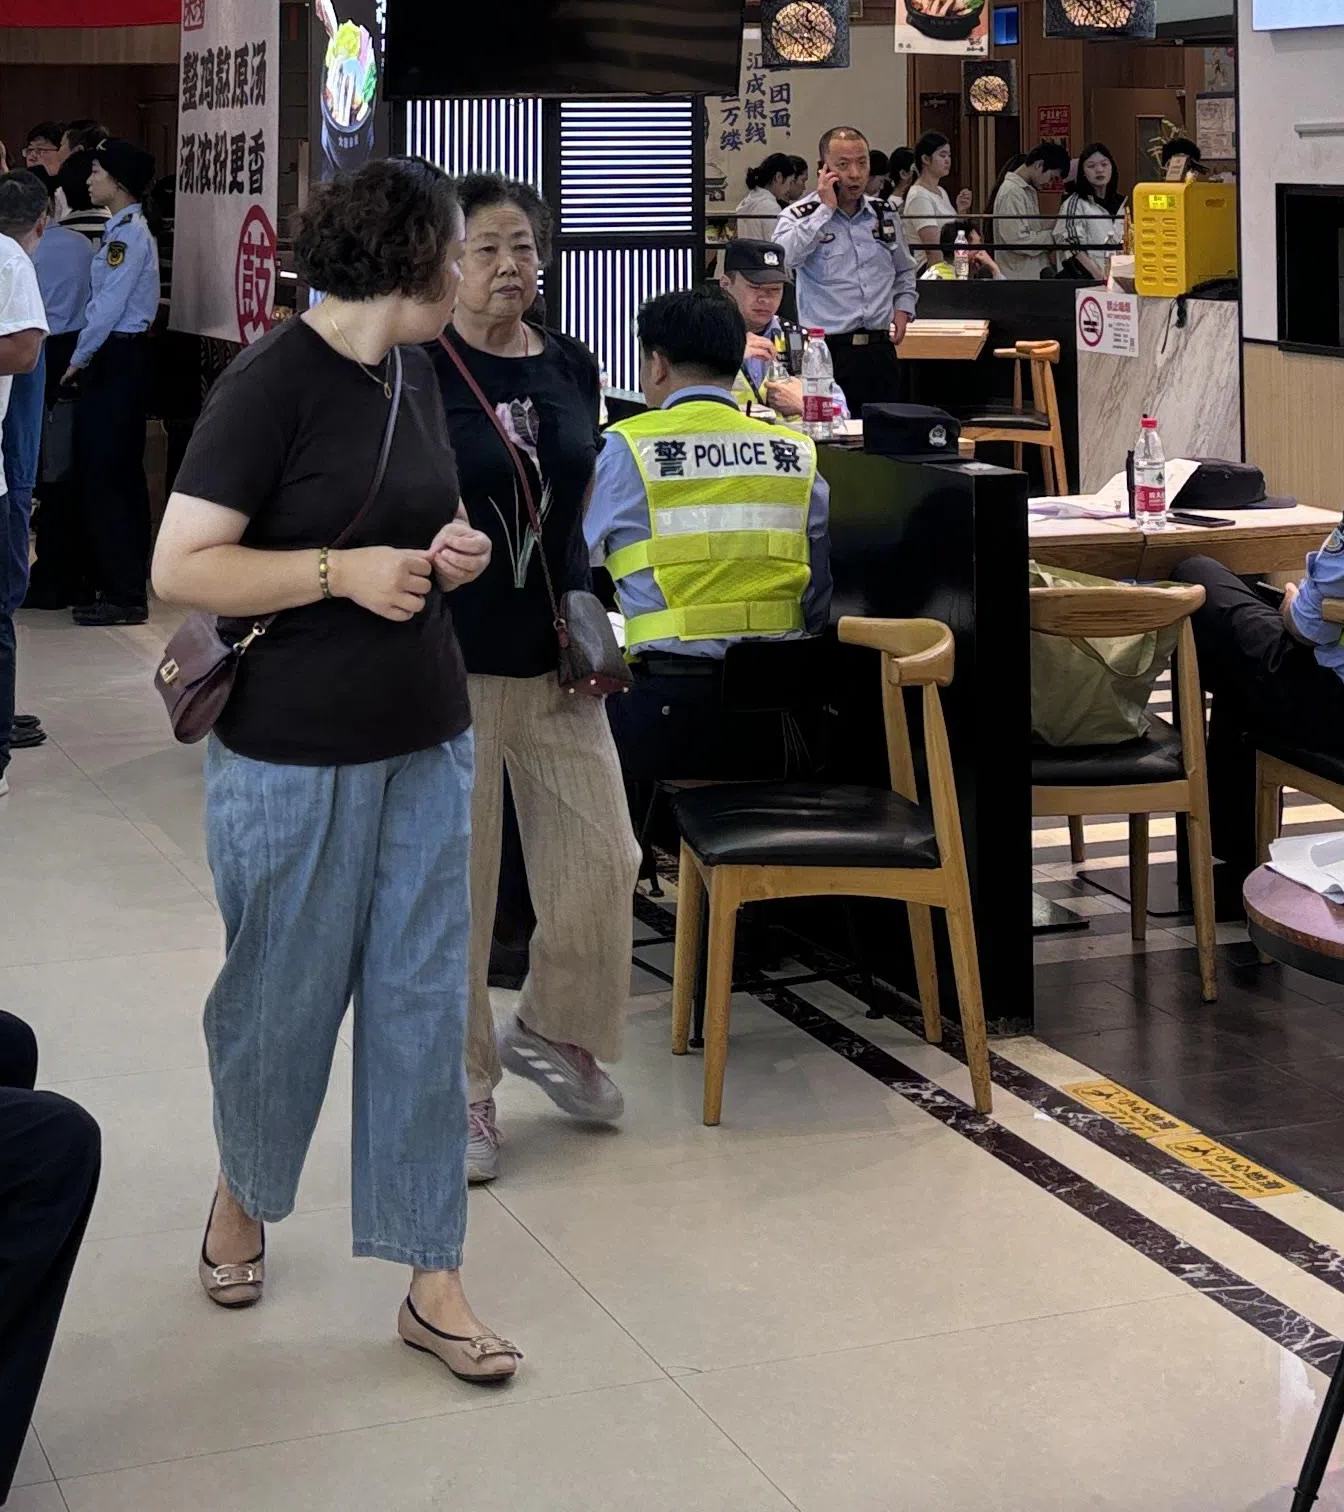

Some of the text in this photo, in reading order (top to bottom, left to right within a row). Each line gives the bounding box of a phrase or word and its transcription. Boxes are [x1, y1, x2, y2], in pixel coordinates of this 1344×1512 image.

[181, 40, 267, 113] 整鸡熬原汤
[719, 96, 743, 151] 万缕
[179, 128, 266, 195] 汤浓粉更香
[654, 439, 802, 477] 警 POLICE 察
